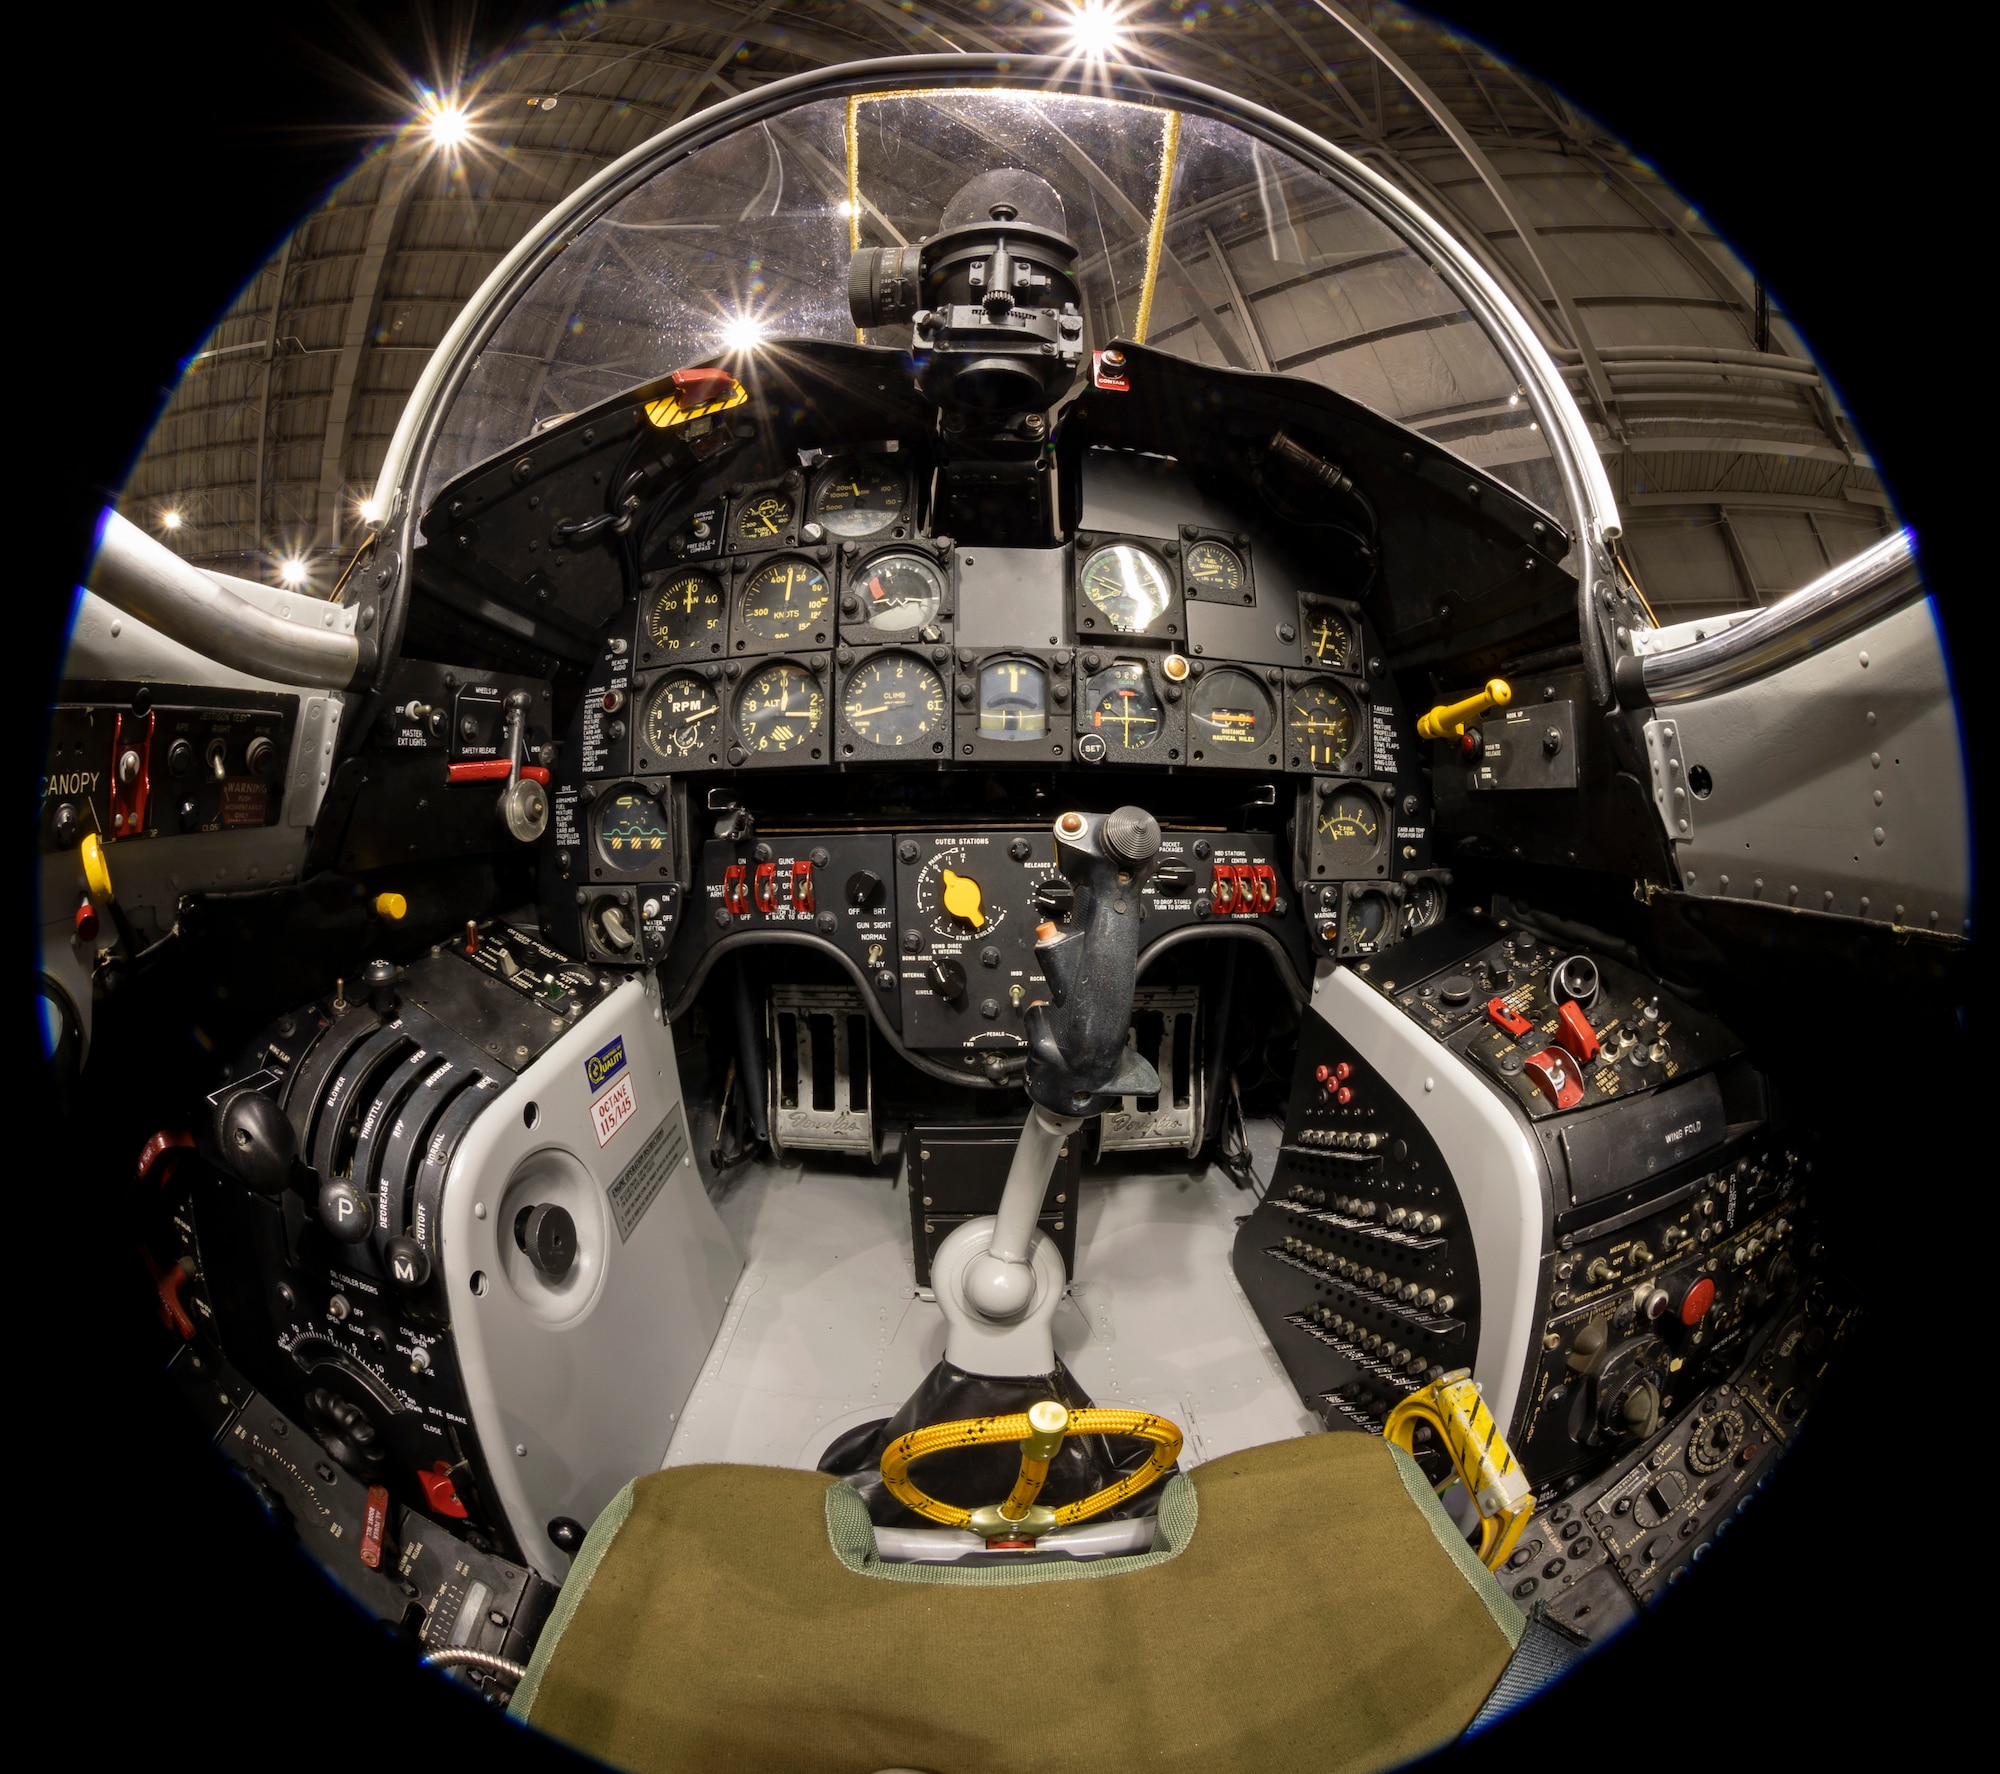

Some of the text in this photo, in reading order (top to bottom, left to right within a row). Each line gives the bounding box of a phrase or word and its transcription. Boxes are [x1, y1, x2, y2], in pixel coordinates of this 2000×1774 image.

[1098, 378, 1126, 386] CONTAM
[770, 575, 786, 584] 400
[796, 574, 806, 582] 50
[664, 600, 678, 610] 20
[704, 594, 718, 604] 40
[808, 600, 822, 608] 100
[753, 608, 769, 616] 300
[773, 610, 800, 620] KNOTS
[659, 626, 668, 636] 10
[668, 640, 680, 649] 70
[612, 658, 628, 666] BEACON
[475, 686, 491, 694] WHEELS
[588, 686, 606, 694] LANDING
[672, 700, 702, 713] RPM
[764, 699, 781, 708] ALT
[1373, 704, 1393, 712] TAKEOFF
[232, 714, 248, 722] TEST
[402, 730, 423, 738] MASTER
[1374, 729, 1397, 738] PROPELLER
[398, 738, 427, 747] EXT LIGHTS
[40, 772, 100, 798] CANOPY
[227, 782, 268, 794] WARNING
[918, 852, 942, 884] START PAIRS
[507, 928, 532, 943] OXYGEN
[974, 926, 996, 940] SINGLES
[474, 956, 484, 966] TEST
[390, 1019, 403, 1030] LOW
[410, 1050, 427, 1064] OPEN
[425, 1062, 454, 1088] INCREASE
[476, 1076, 492, 1090] RICH
[327, 1076, 346, 1108] BLOWER
[598, 1084, 628, 1118] OCTANE
[360, 1099, 384, 1140] THROTTLE
[600, 1096, 632, 1136] 115/145
[1111, 1112, 1183, 1137] Douglas
[1664, 1120, 1702, 1144] WING FOLD
[426, 1132, 446, 1167] NORMAL
[338, 1198, 354, 1222] P
[380, 1178, 390, 1229] DECREASE
[416, 1203, 426, 1241] CUTOFF
[1610, 1240, 1632, 1254] MEDIUM
[1676, 1236, 1695, 1250] NORMAL
[1612, 1256, 1624, 1266] OFF
[1651, 1260, 1665, 1272] EMER
[394, 1260, 415, 1282] M
[330, 1280, 345, 1291] AUTO
[359, 1282, 379, 1296] DOORS
[1574, 1283, 1614, 1304] INSTRUMENTS
[353, 1308, 364, 1318] OFF
[1592, 1300, 1616, 1315] INVERTER
[326, 1313, 340, 1325] OPEN
[1564, 1312, 1590, 1326] INVERTER
[348, 1323, 366, 1337] CLOSE
[396, 1344, 412, 1355] OPEN
[1538, 1371, 1550, 1402] AUTO
[404, 1402, 423, 1414] DOWN
[428, 1406, 468, 1424] DIVE BRAKE
[422, 1423, 442, 1436] CLOSE
[1526, 1406, 1541, 1444] PILOT
[1664, 1446, 1683, 1466] UNLOCK
[1698, 1478, 1708, 1490] ADF
[1688, 1506, 1698, 1518] OFF
[1624, 1528, 1648, 1550] CHAN
[1640, 1560, 1658, 1580] VOL
